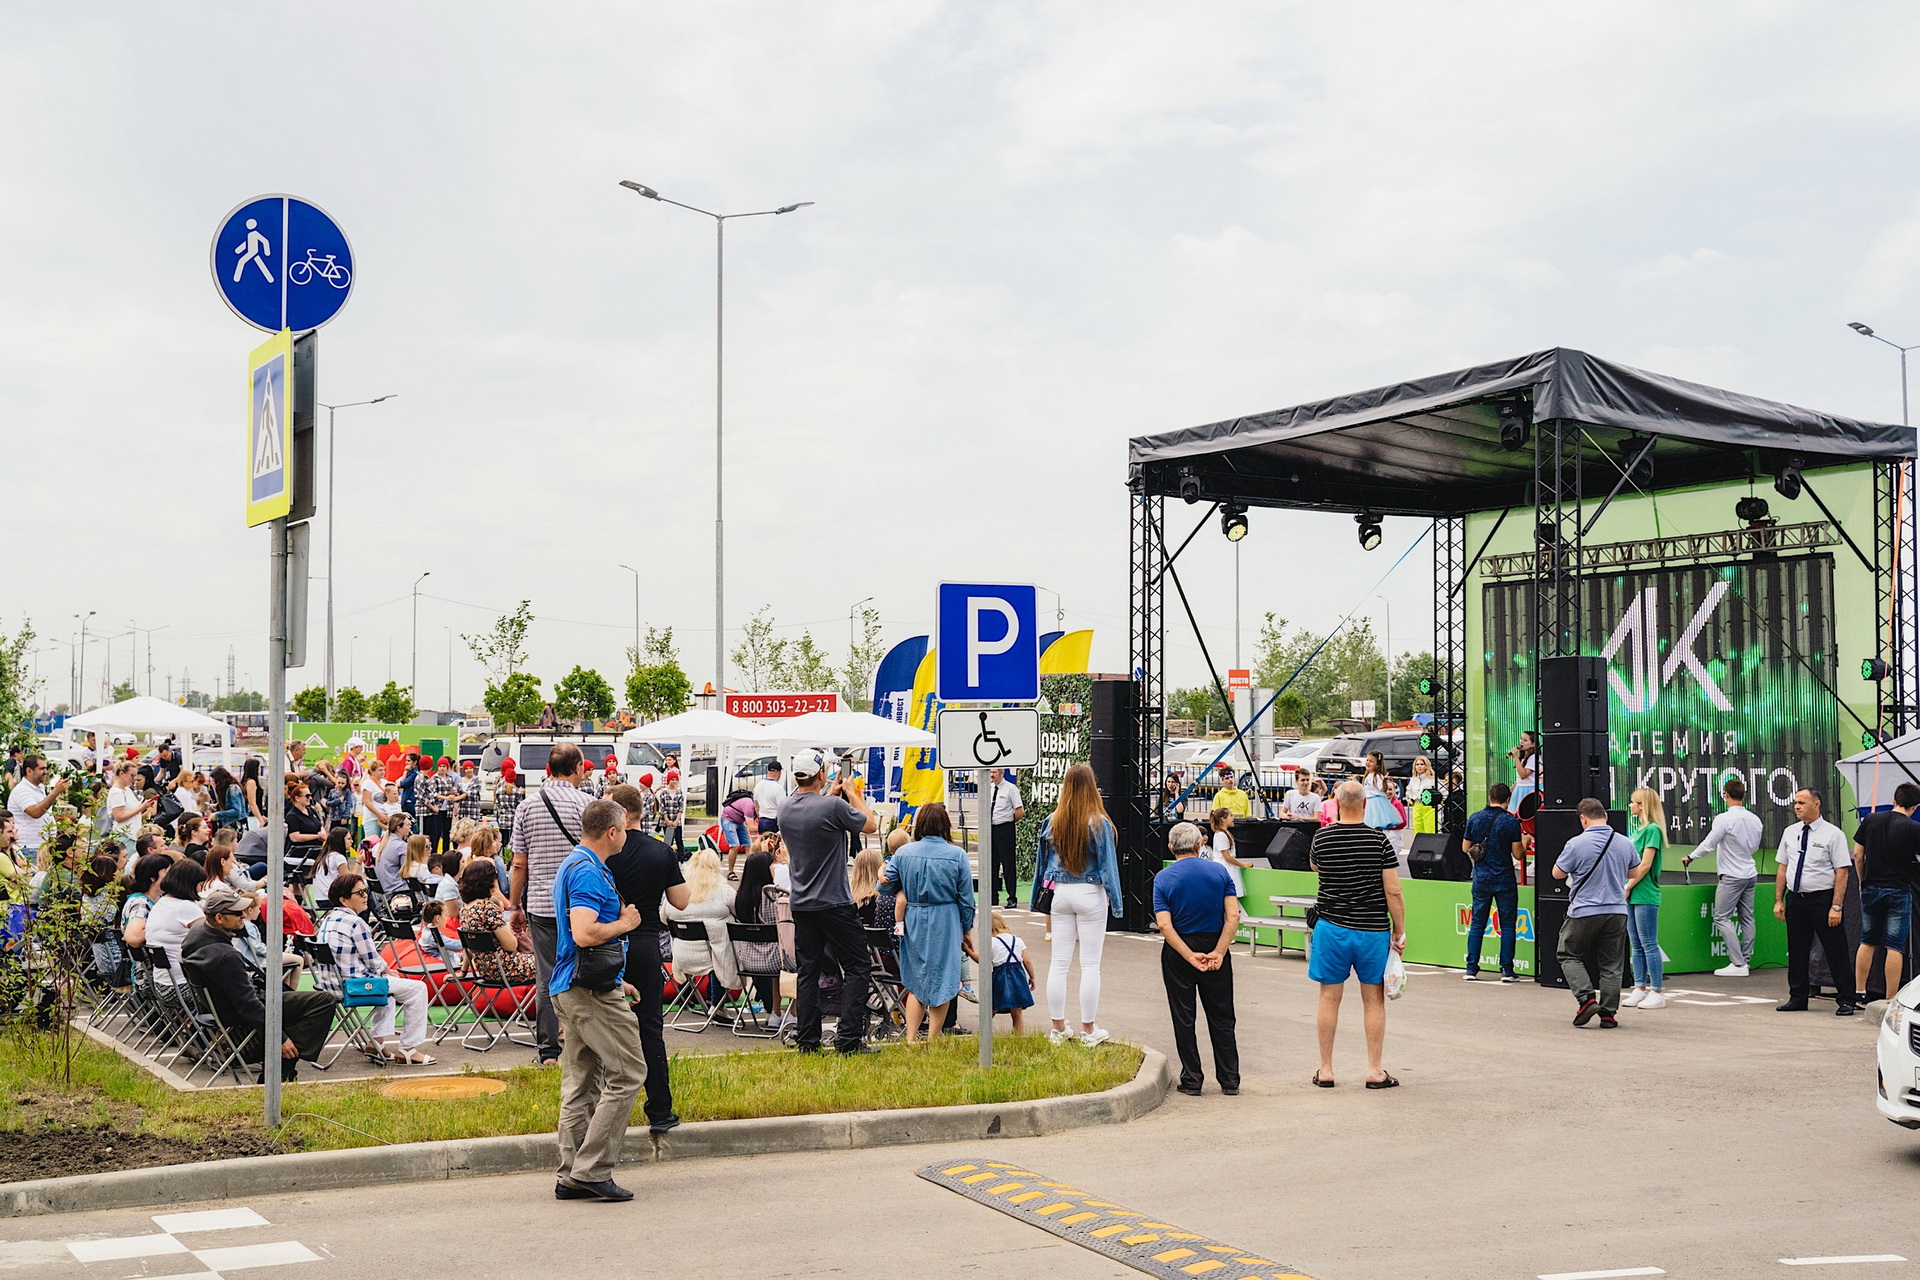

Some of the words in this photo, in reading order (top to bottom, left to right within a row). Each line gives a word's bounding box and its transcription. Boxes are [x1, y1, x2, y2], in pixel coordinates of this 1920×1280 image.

[967, 596, 1020, 687] P
[732, 700, 740, 713] 8
[742, 700, 763, 713] 800
[766, 699, 830, 713] 303-22-22
[352, 730, 400, 741] ДЕТСКАЯ
[1041, 727, 1079, 754] ОВЫЙ
[1608, 730, 1738, 759] АДЕМИЯ
[1636, 766, 1799, 807] КРУТОГО
